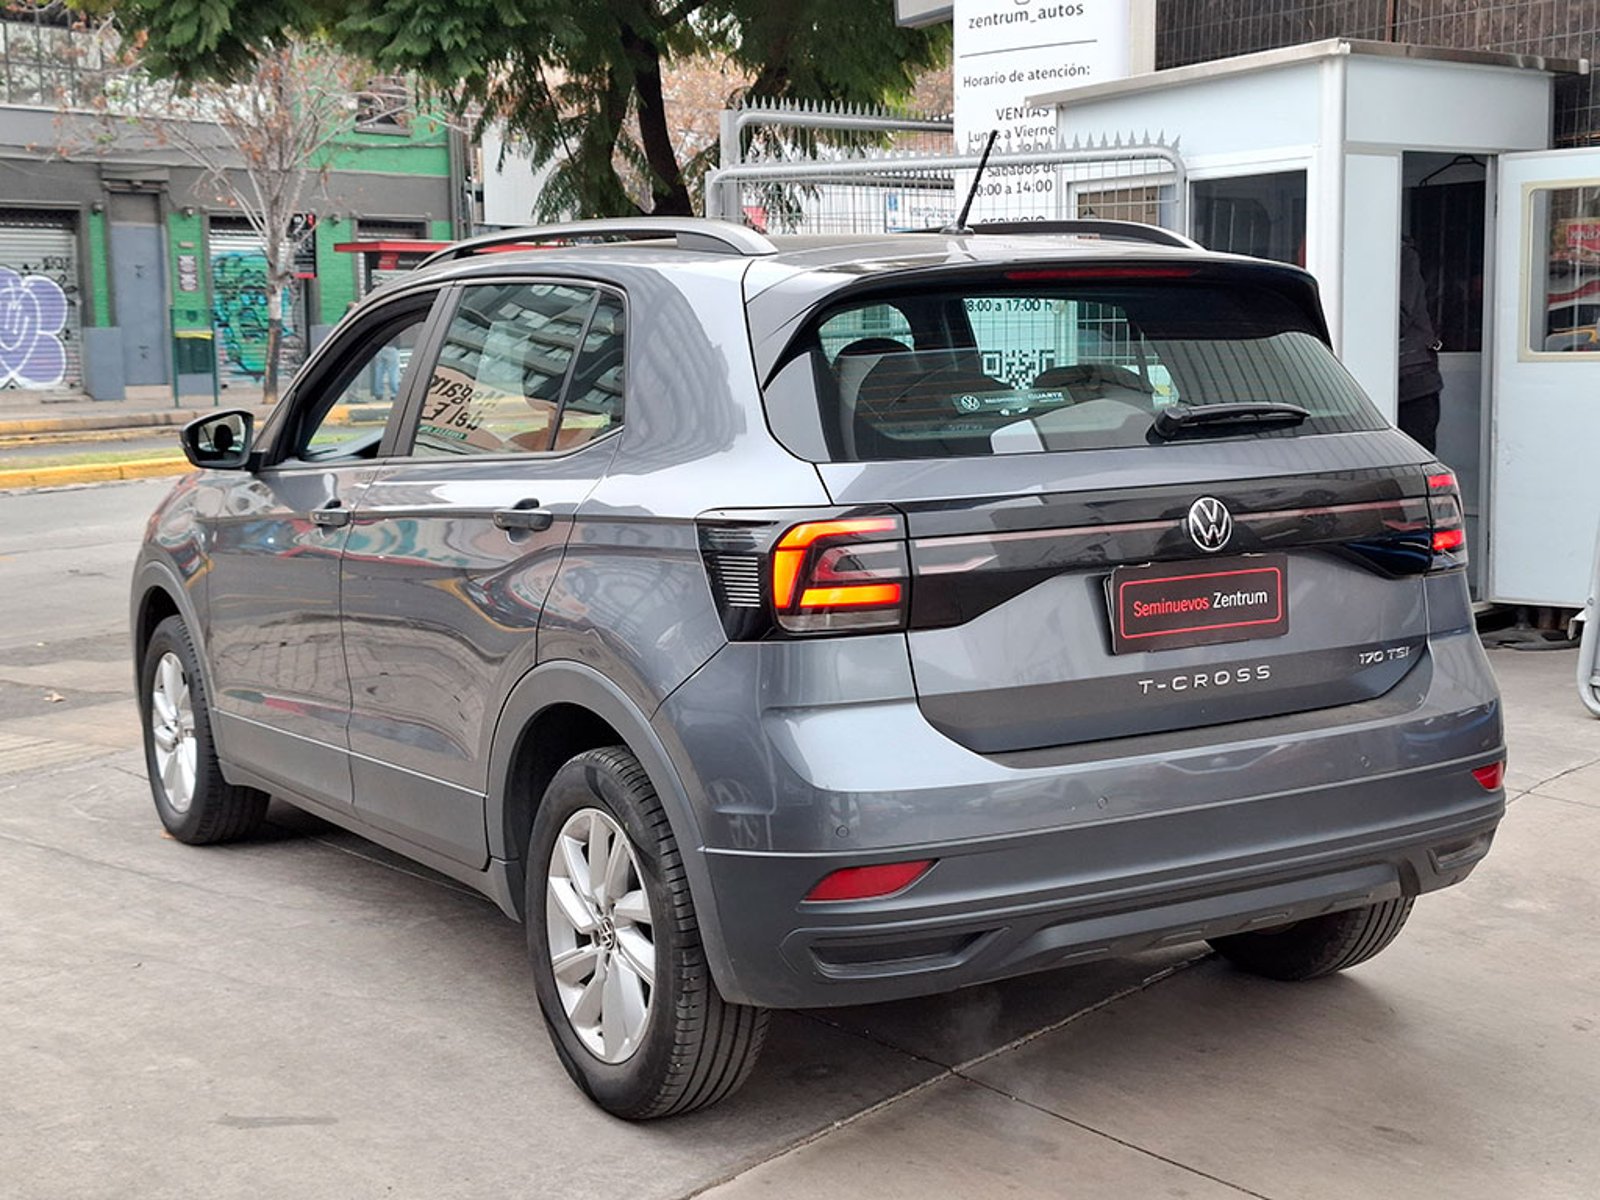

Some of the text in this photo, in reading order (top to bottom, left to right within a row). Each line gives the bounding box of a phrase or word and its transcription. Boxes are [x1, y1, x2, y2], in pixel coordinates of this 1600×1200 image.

[968, 3, 1084, 29] zentrum_autos
[963, 63, 1091, 88] Horario de atención:
[996, 106, 1050, 120] VENTAS
[1004, 129, 1012, 140] a
[1005, 184, 1012, 194] a
[1016, 179, 1053, 194] 14:00
[994, 302, 1002, 312] a
[1007, 298, 1041, 312] 17:00
[1133, 590, 1268, 617] Seminuevos Zentrum
[1359, 646, 1410, 664] 170 TSI
[1138, 664, 1271, 694] T-CROSS
